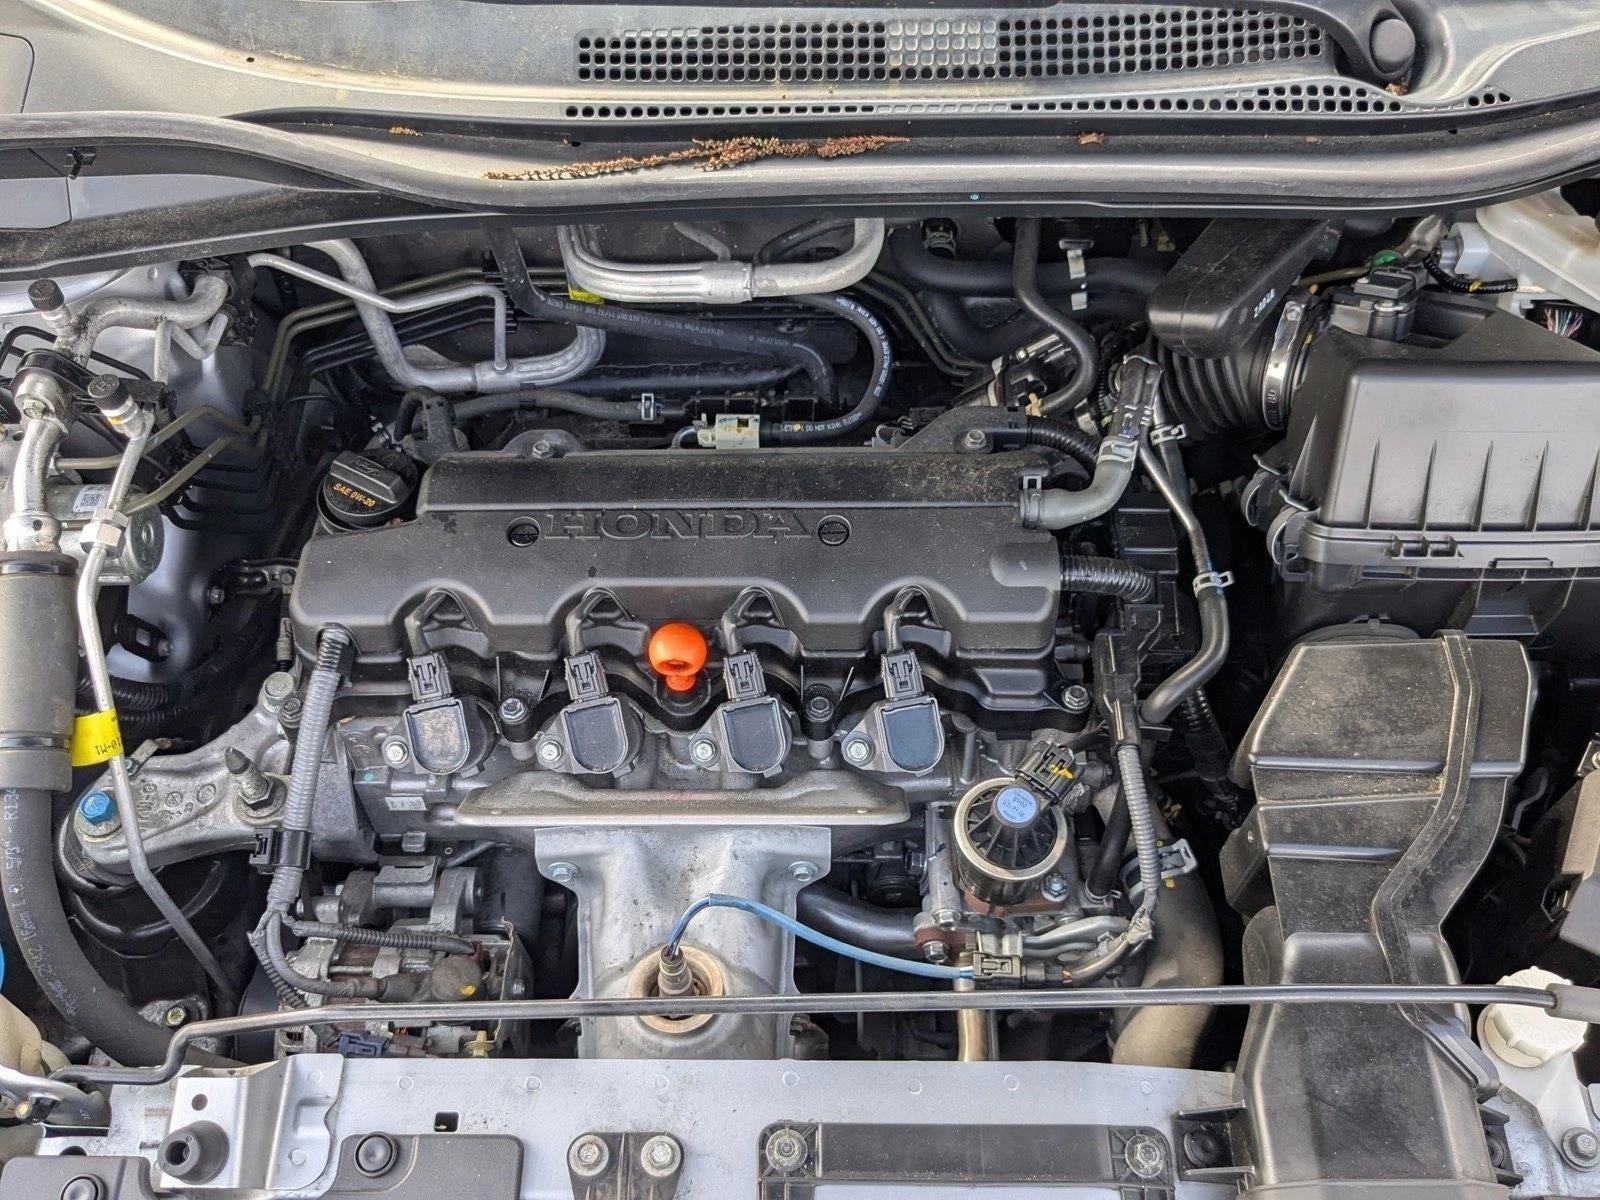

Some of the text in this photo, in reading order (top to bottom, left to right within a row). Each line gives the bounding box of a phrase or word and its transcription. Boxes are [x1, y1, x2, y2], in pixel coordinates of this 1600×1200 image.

[333, 483, 376, 507] SAE 0W-20
[545, 510, 812, 539] HONDA
